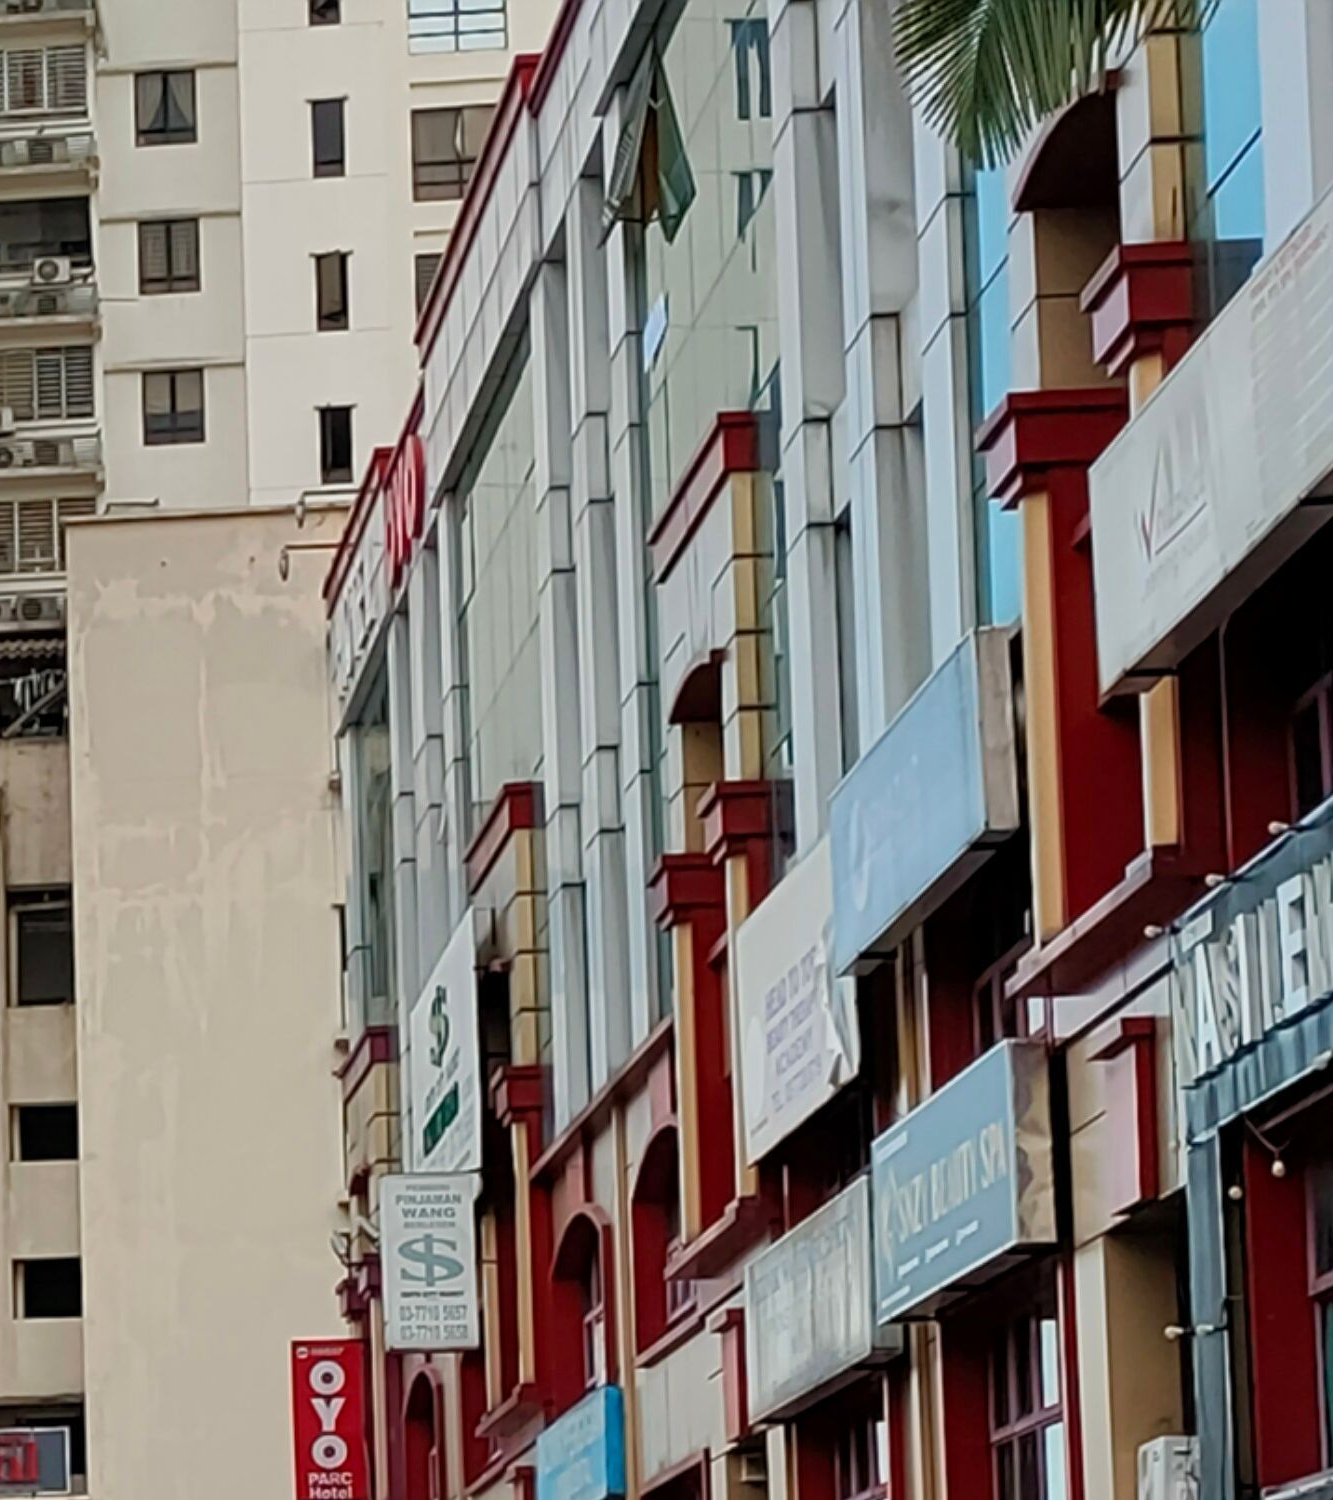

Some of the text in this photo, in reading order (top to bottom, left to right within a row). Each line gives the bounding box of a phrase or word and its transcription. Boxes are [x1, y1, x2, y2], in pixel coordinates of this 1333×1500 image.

[401, 1207, 457, 1219] WANG
[309, 1360, 349, 1469] OYO
[307, 1472, 354, 1486] PARC
[308, 1486, 354, 1500] Hotel
